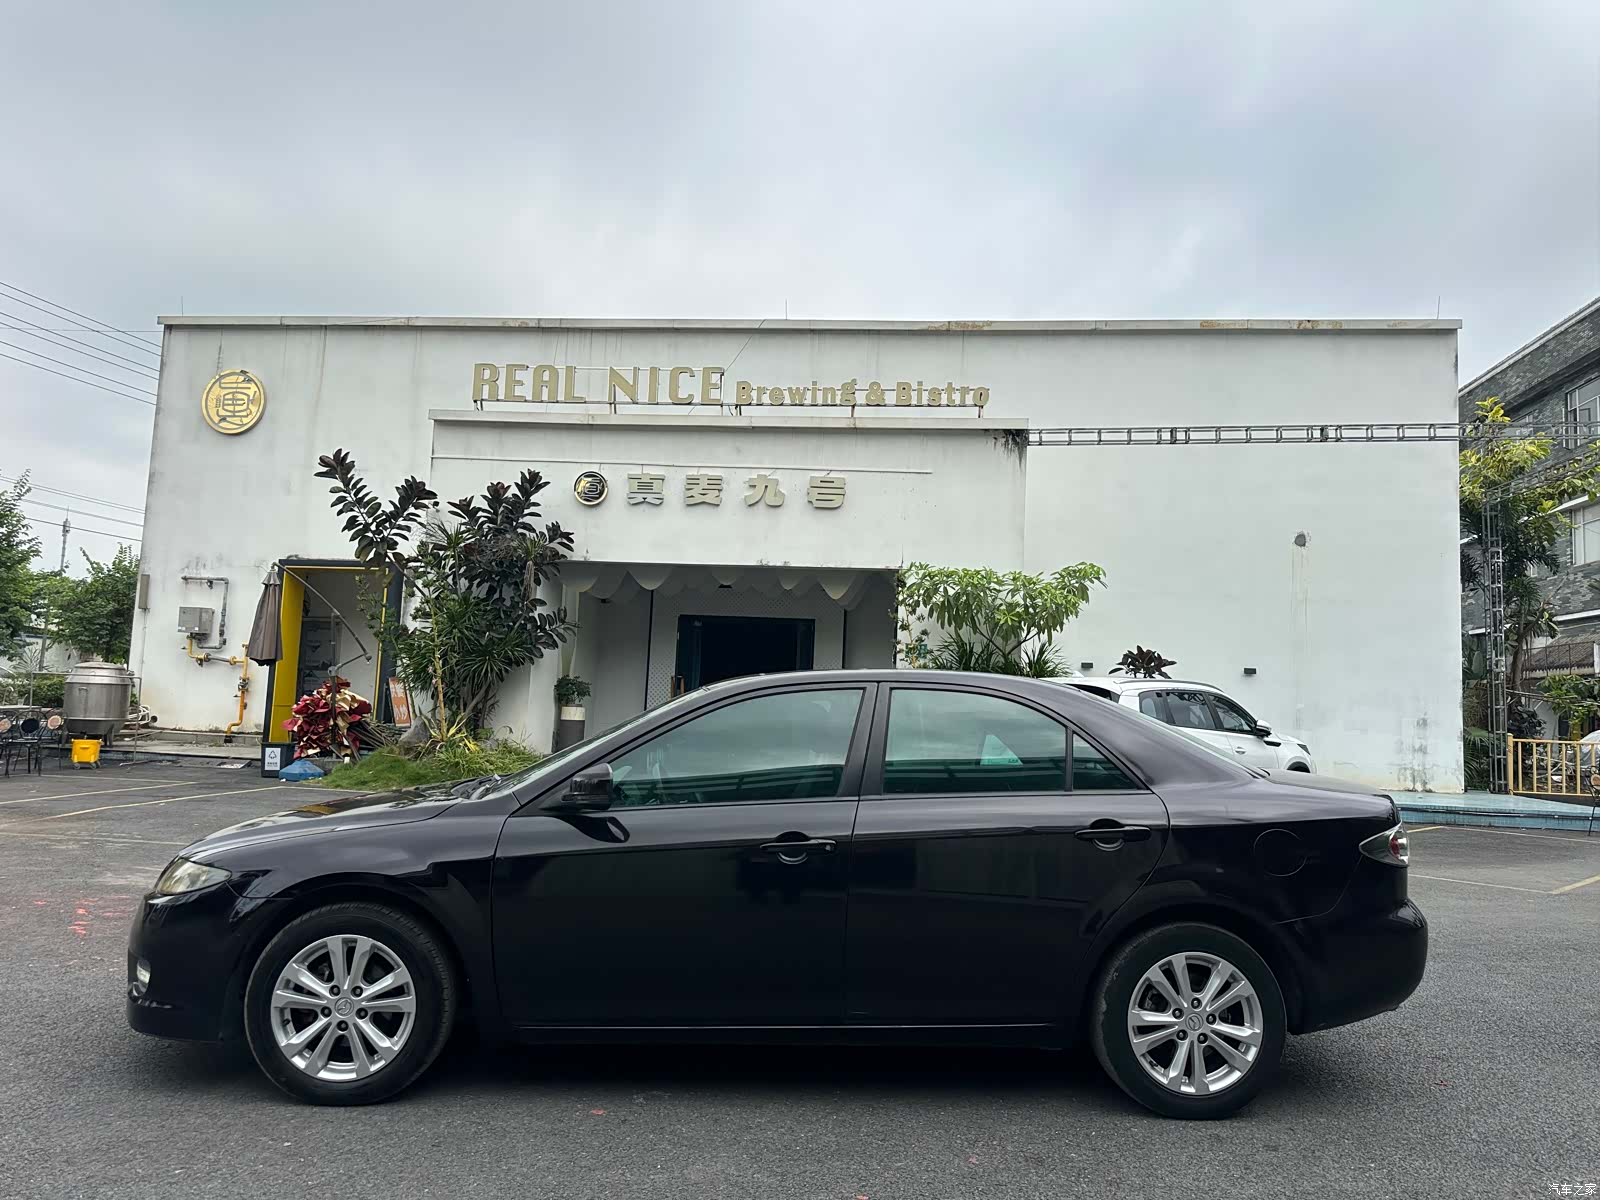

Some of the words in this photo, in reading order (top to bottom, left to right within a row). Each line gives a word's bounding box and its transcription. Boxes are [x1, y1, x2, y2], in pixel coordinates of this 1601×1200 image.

[473, 364, 586, 403] REAL
[608, 366, 724, 404] NICE
[736, 379, 857, 406] Brewing
[865, 381, 885, 406] &
[896, 381, 990, 407] Bistro
[627, 473, 846, 508] 真麦九号
